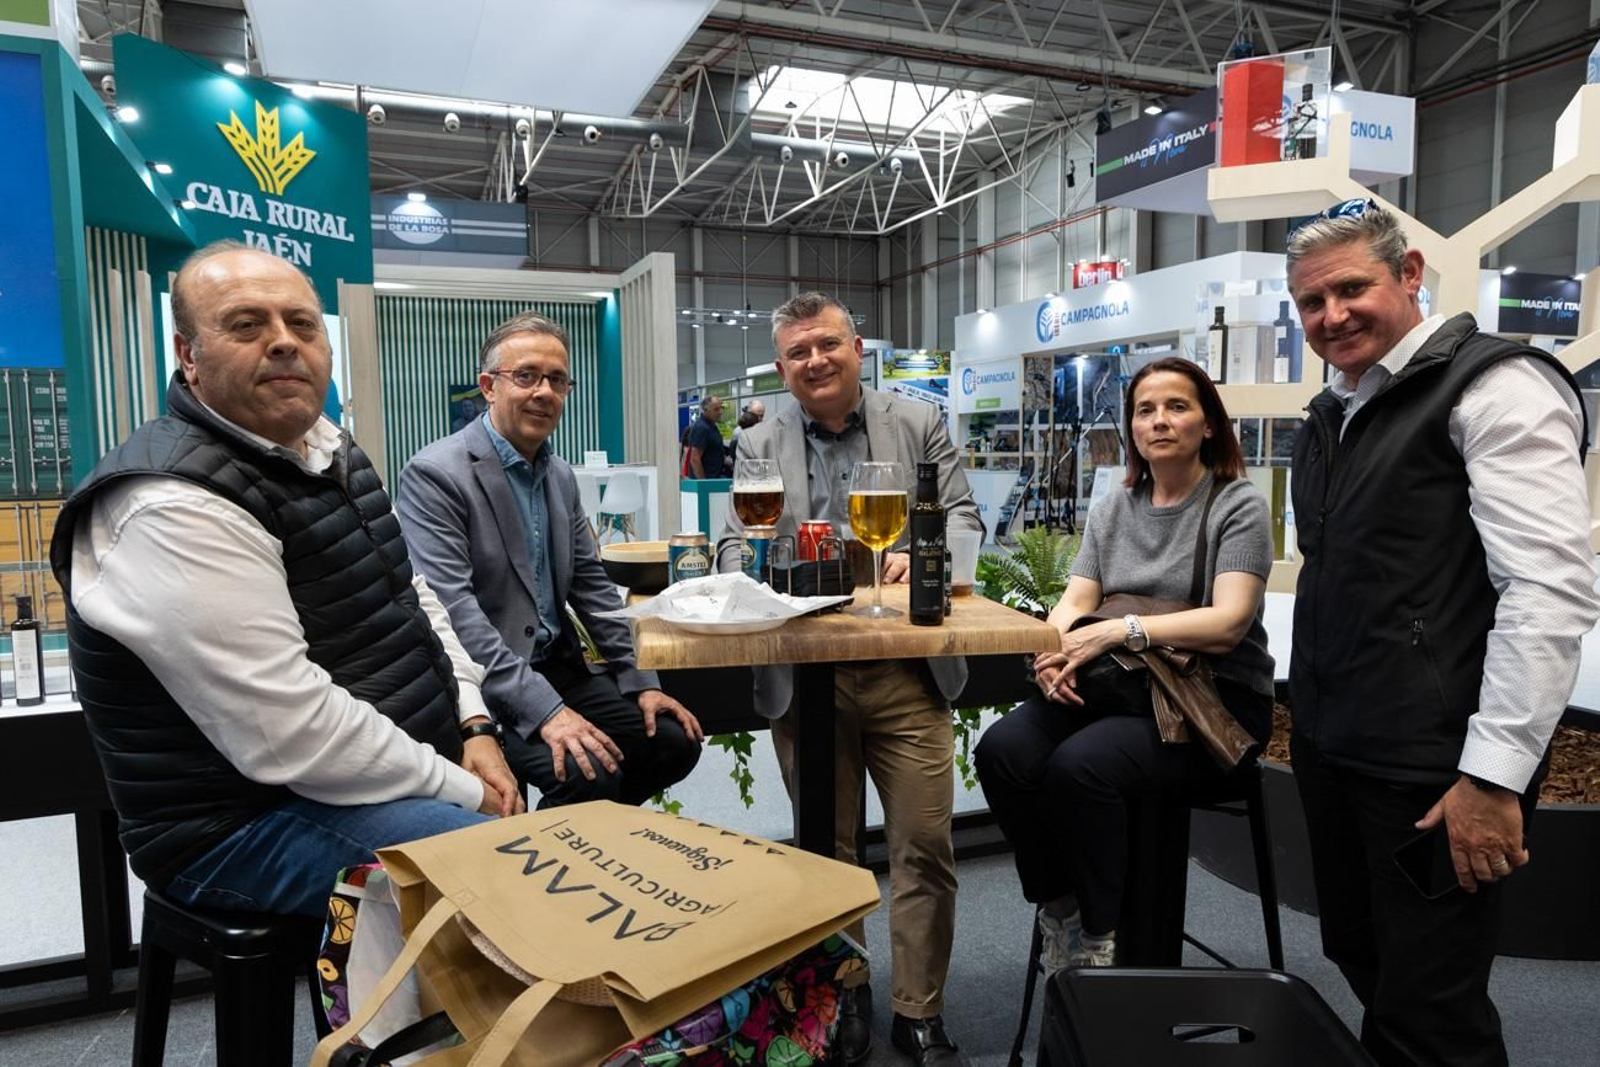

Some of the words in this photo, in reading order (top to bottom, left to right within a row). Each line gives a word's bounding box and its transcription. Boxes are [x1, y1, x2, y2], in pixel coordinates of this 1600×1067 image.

[1350, 120, 1393, 141] GNOLA
[1124, 144, 1157, 166] MADE
[1159, 137, 1173, 151] IN
[1174, 123, 1209, 147] ITALY
[186, 182, 262, 222] CAJA
[265, 199, 355, 242] RURAL
[388, 214, 448, 226] INDUSTRIAS
[388, 223, 403, 231] DE
[405, 224, 419, 232] LA
[243, 229, 312, 267] JAÉN
[1061, 301, 1129, 326] CAMPAGNOLA
[1521, 299, 1550, 310] MADE
[1552, 301, 1563, 310] IN
[976, 371, 1015, 385] CAMPAGNOLA
